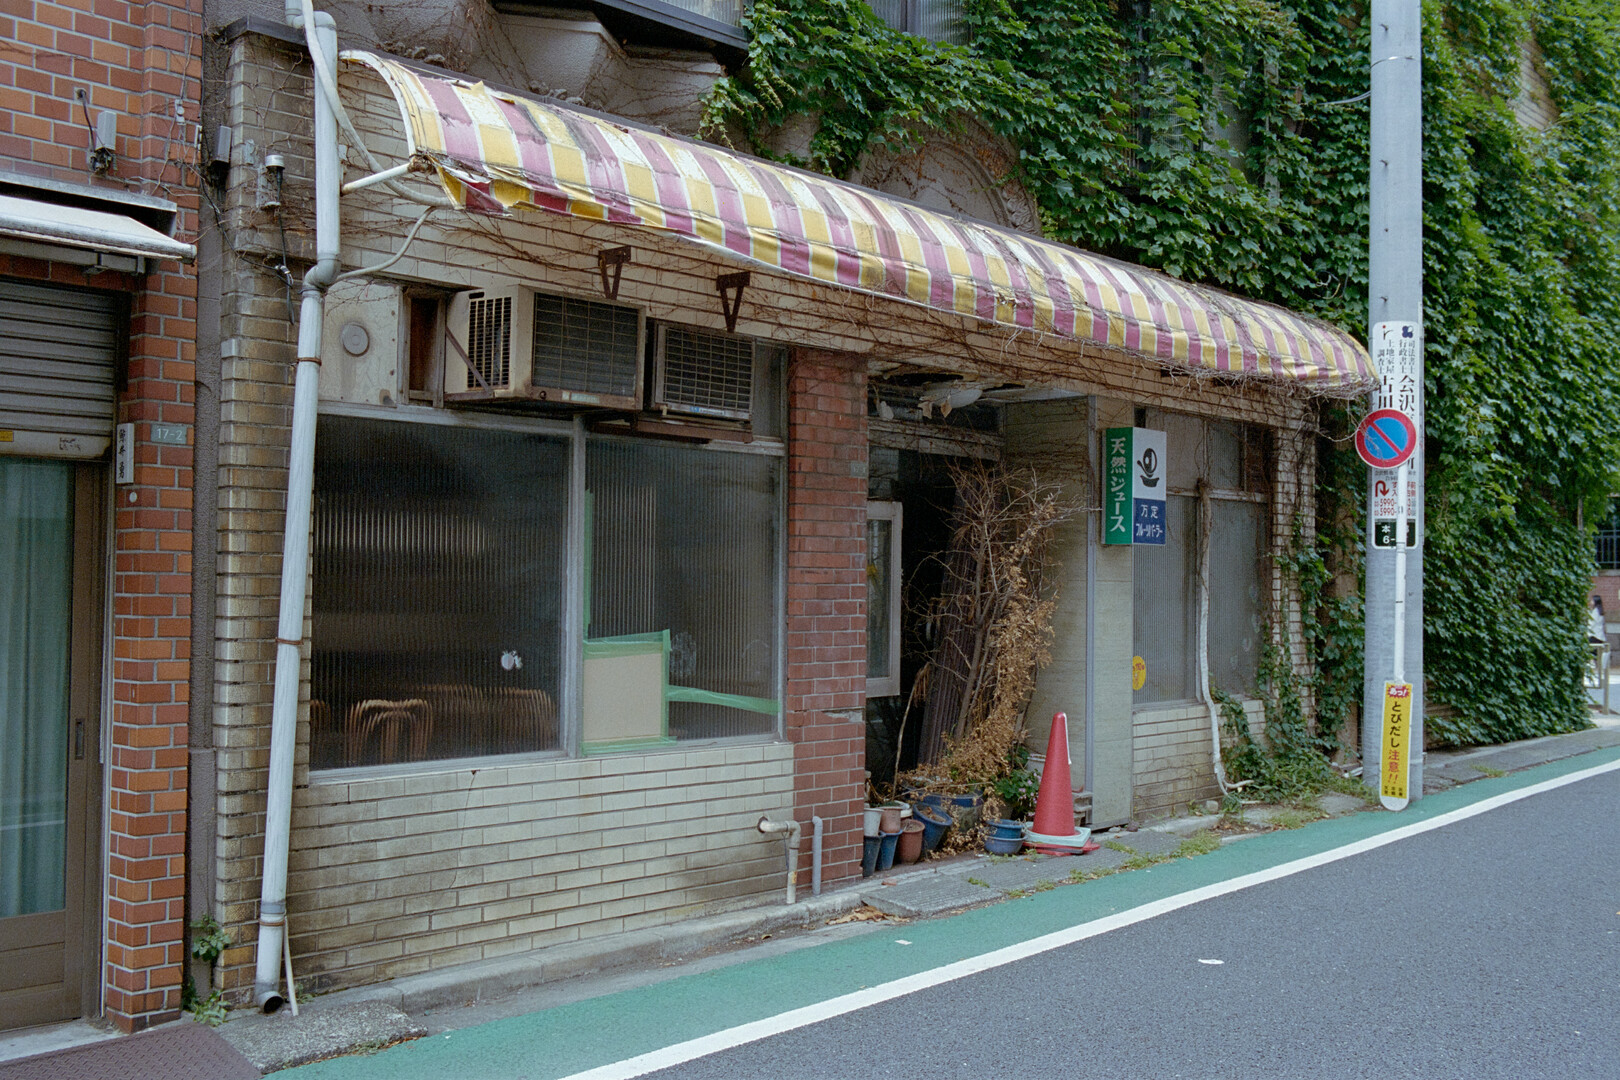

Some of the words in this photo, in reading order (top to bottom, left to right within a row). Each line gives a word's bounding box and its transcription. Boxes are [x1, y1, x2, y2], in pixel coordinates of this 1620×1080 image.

[1399, 339, 1407, 374] 行政書士
[1378, 375, 1394, 410] 古川
[156, 428, 183, 441] 17-2
[1110, 437, 1127, 533] 天然ジュース
[1140, 503, 1159, 519] 万定
[1135, 522, 1164, 538] フルーツパーラー
[1389, 687, 1407, 697] あっ!
